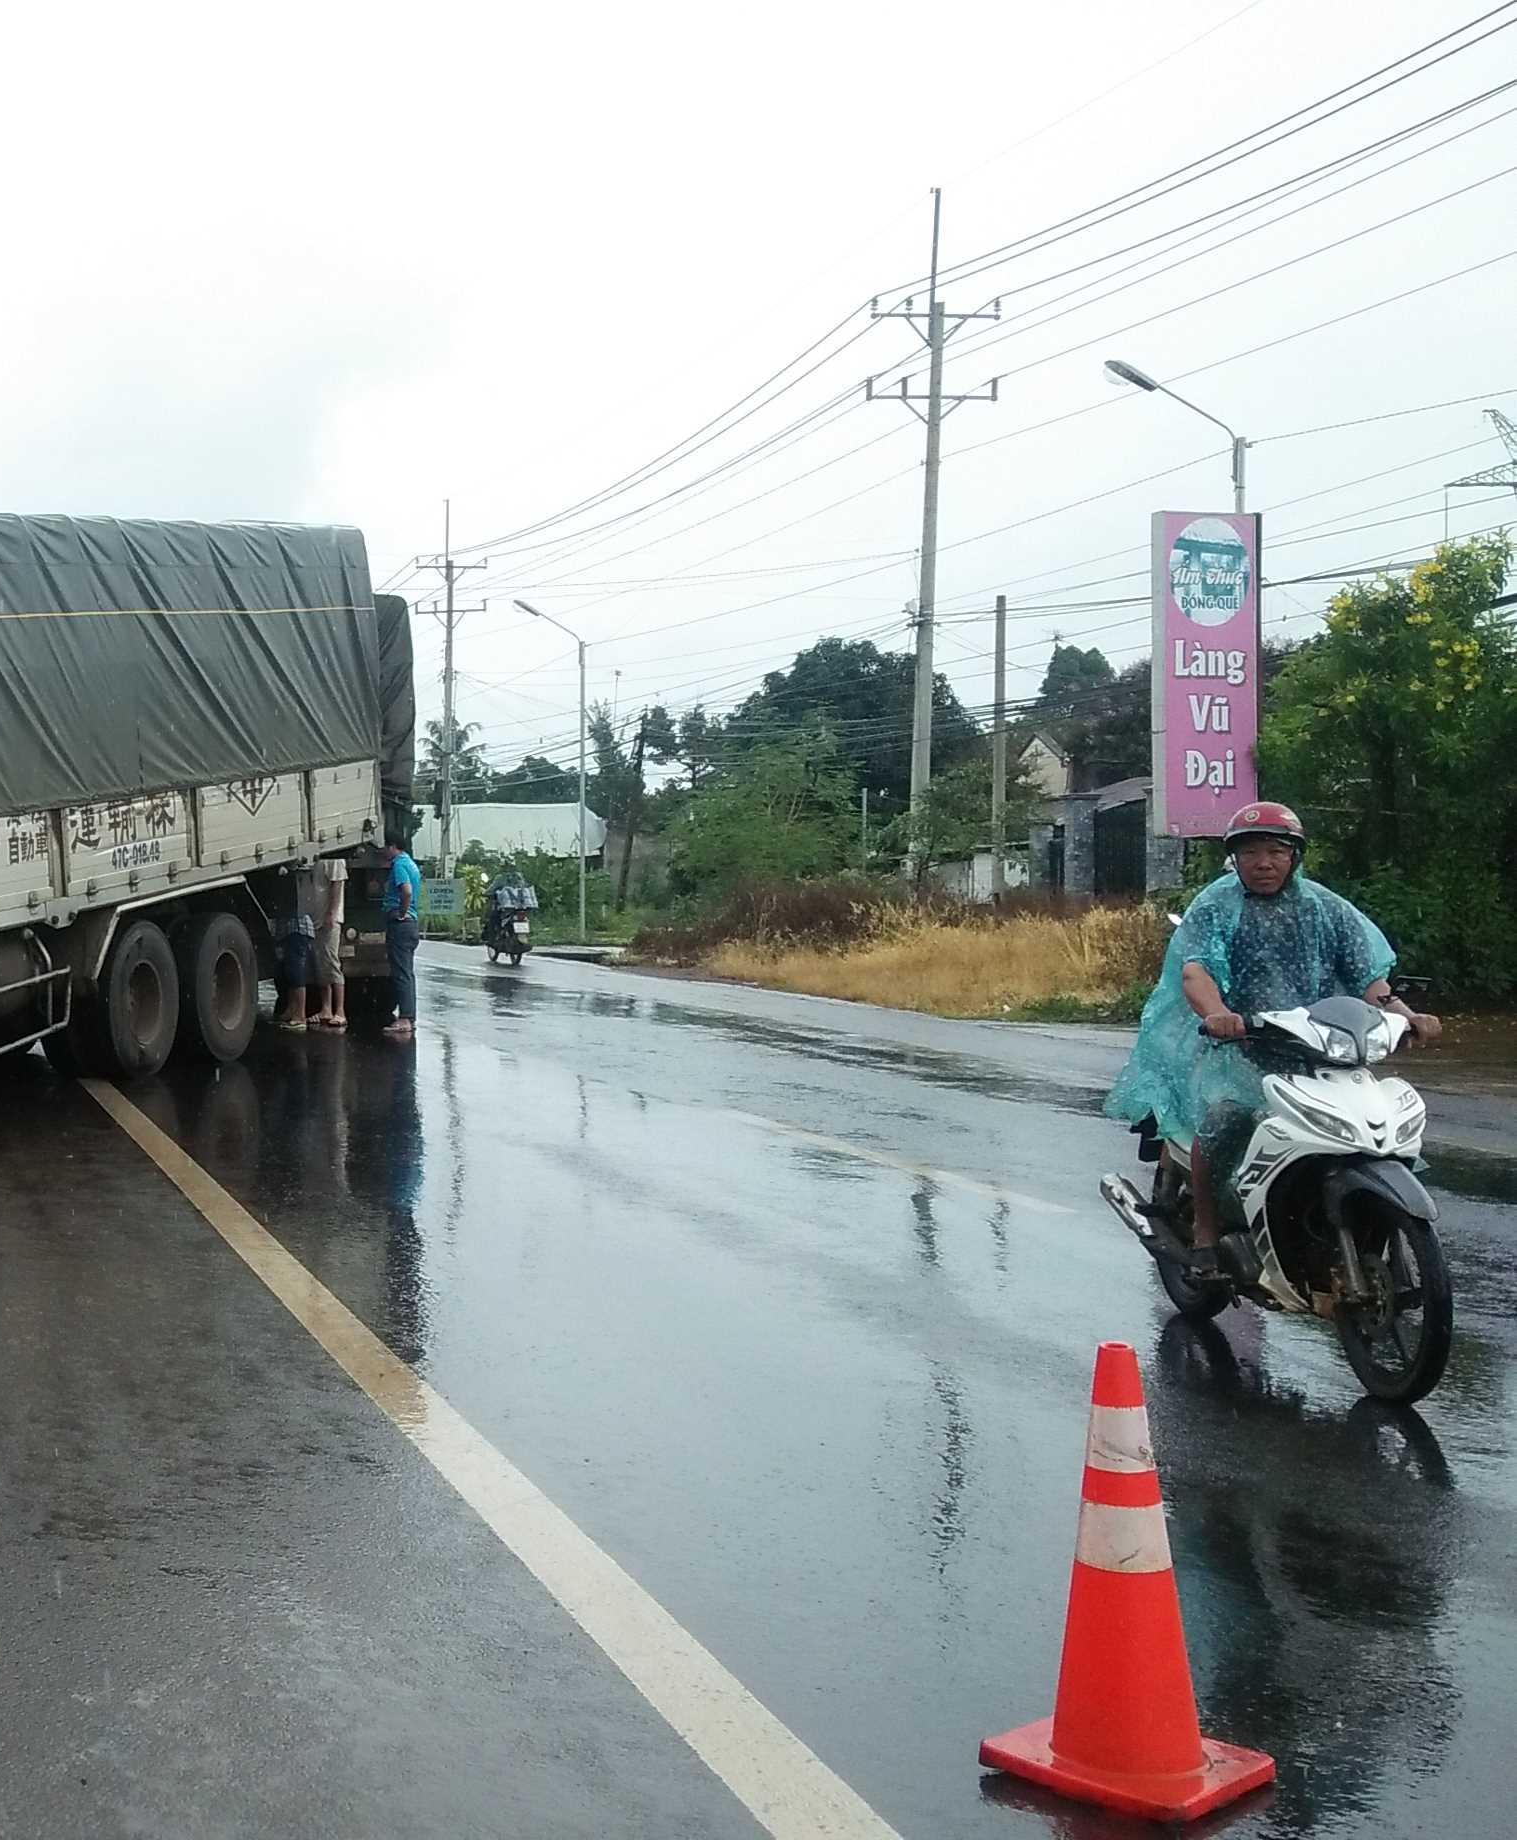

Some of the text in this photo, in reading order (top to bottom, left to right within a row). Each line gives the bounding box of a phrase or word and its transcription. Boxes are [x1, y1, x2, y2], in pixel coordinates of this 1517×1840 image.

[1174, 639, 1246, 684] Làng
[1188, 695, 1231, 733] Vũ
[1184, 749, 1235, 794] Đại
